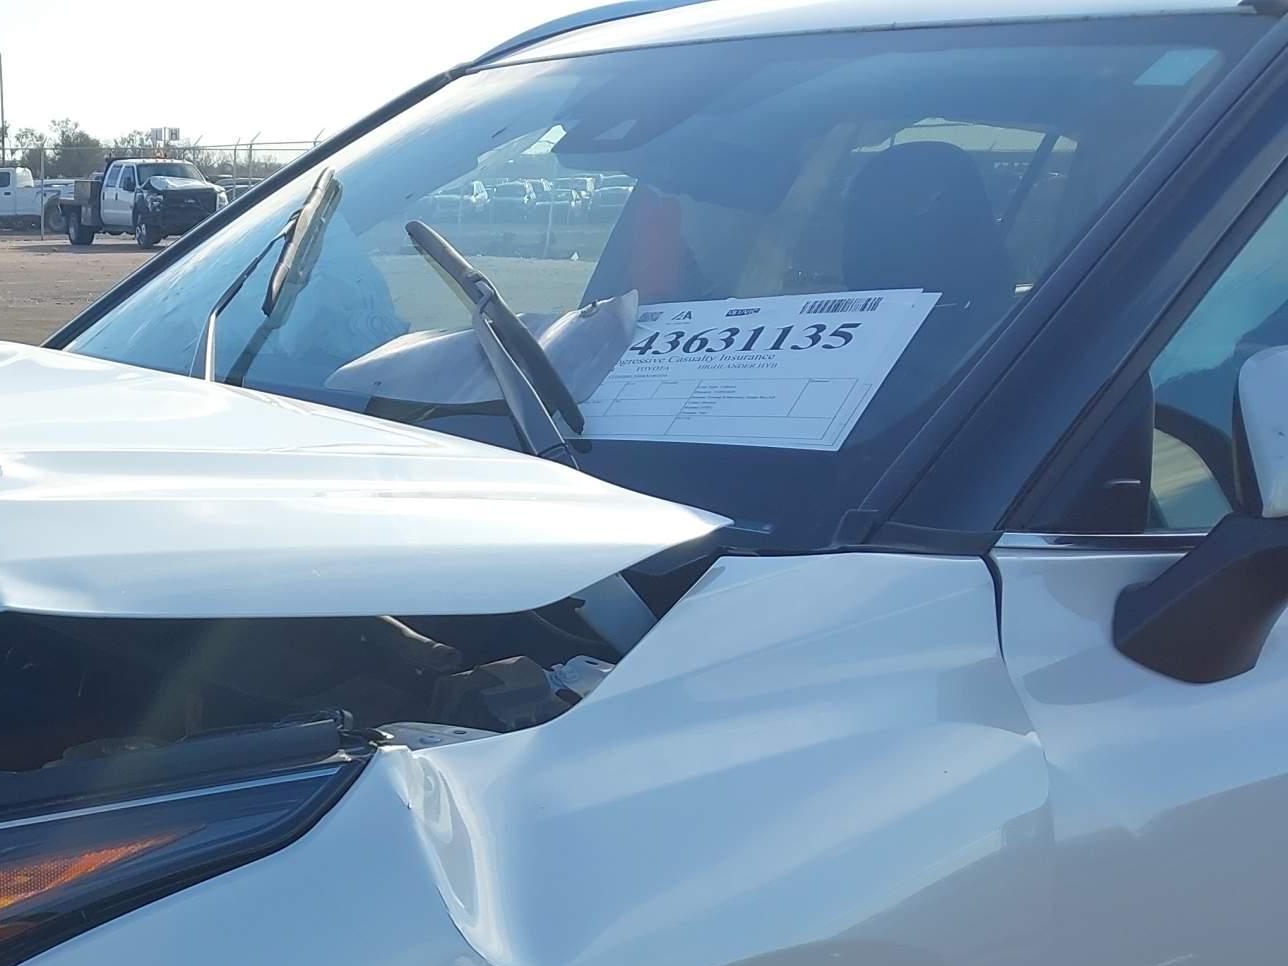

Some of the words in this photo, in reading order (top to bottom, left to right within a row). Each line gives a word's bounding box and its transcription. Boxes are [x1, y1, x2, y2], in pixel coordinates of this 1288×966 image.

[628, 322, 863, 356] 43631135
[668, 354, 715, 365] Casualty
[719, 352, 776, 362] Insurance
